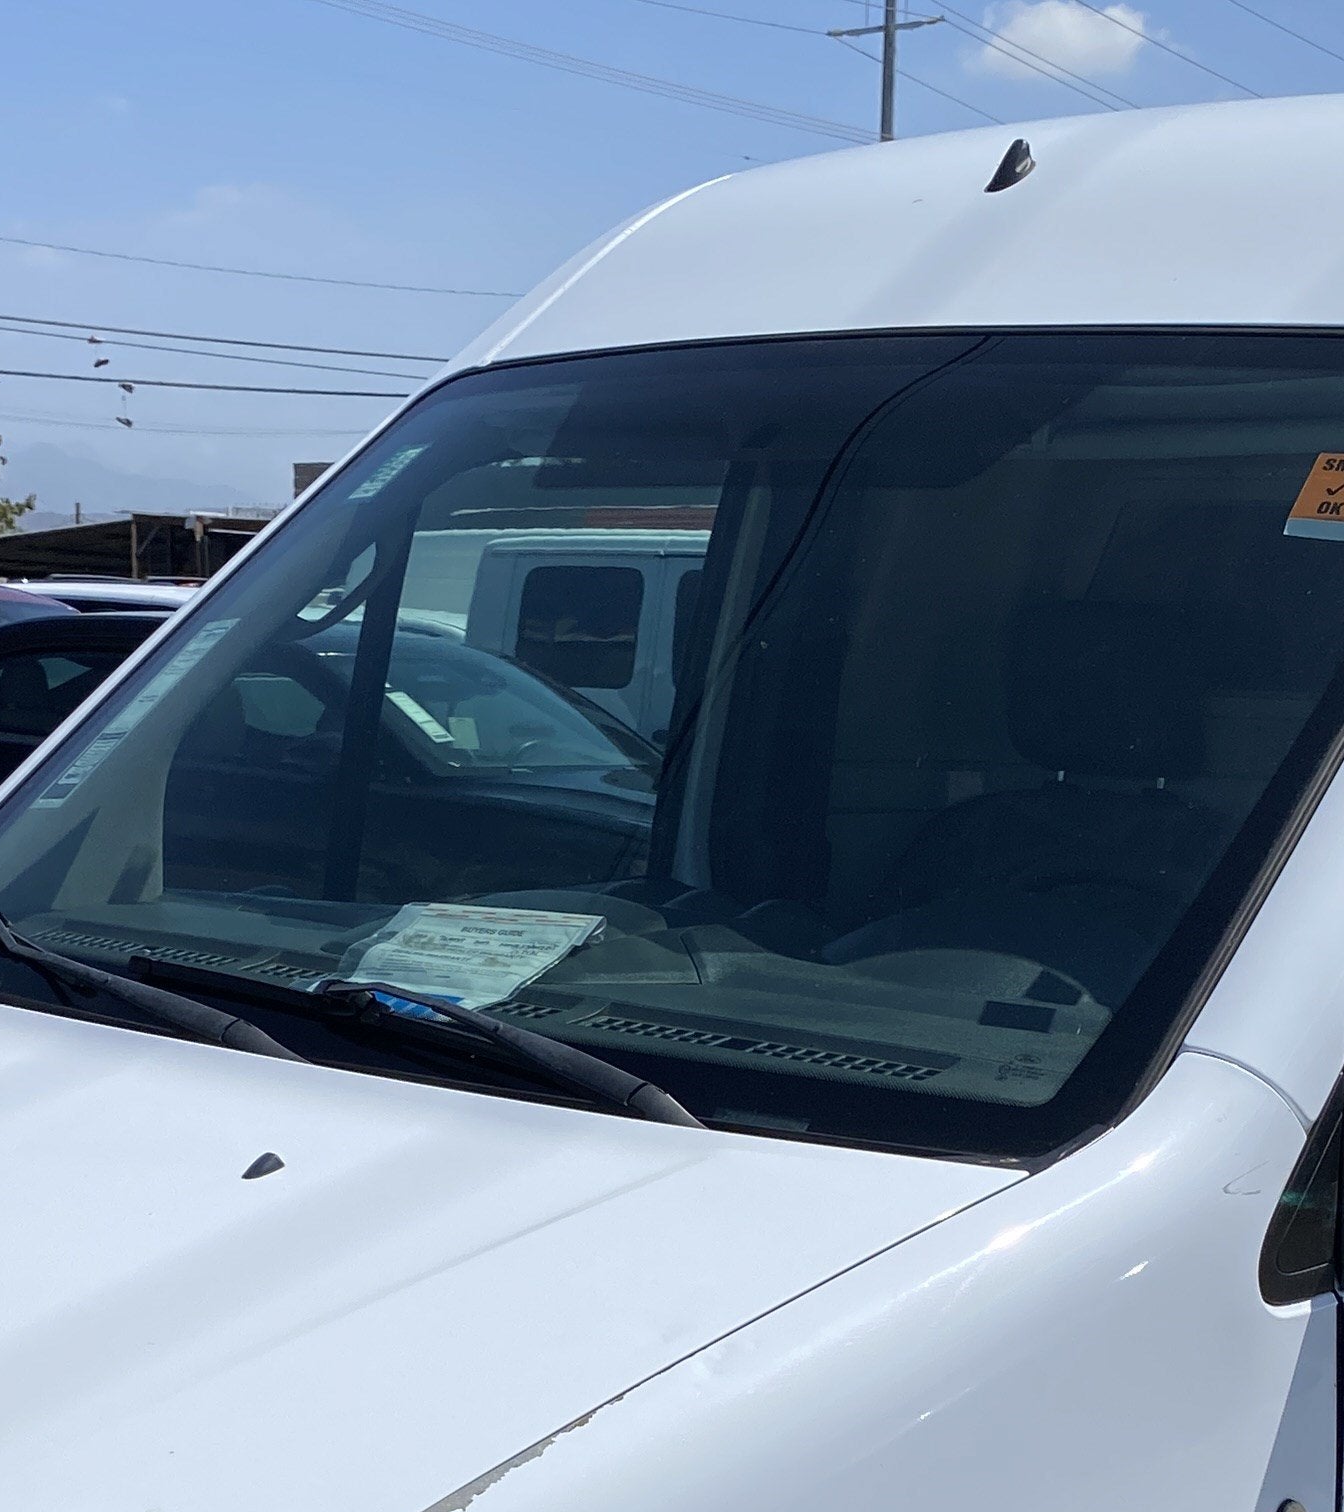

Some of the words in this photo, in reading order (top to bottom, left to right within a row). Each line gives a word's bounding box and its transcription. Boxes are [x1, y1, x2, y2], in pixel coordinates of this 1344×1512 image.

[1317, 501, 1344, 516] OK
[460, 926, 496, 935] BUYERS
[497, 929, 526, 937] GUIDE
